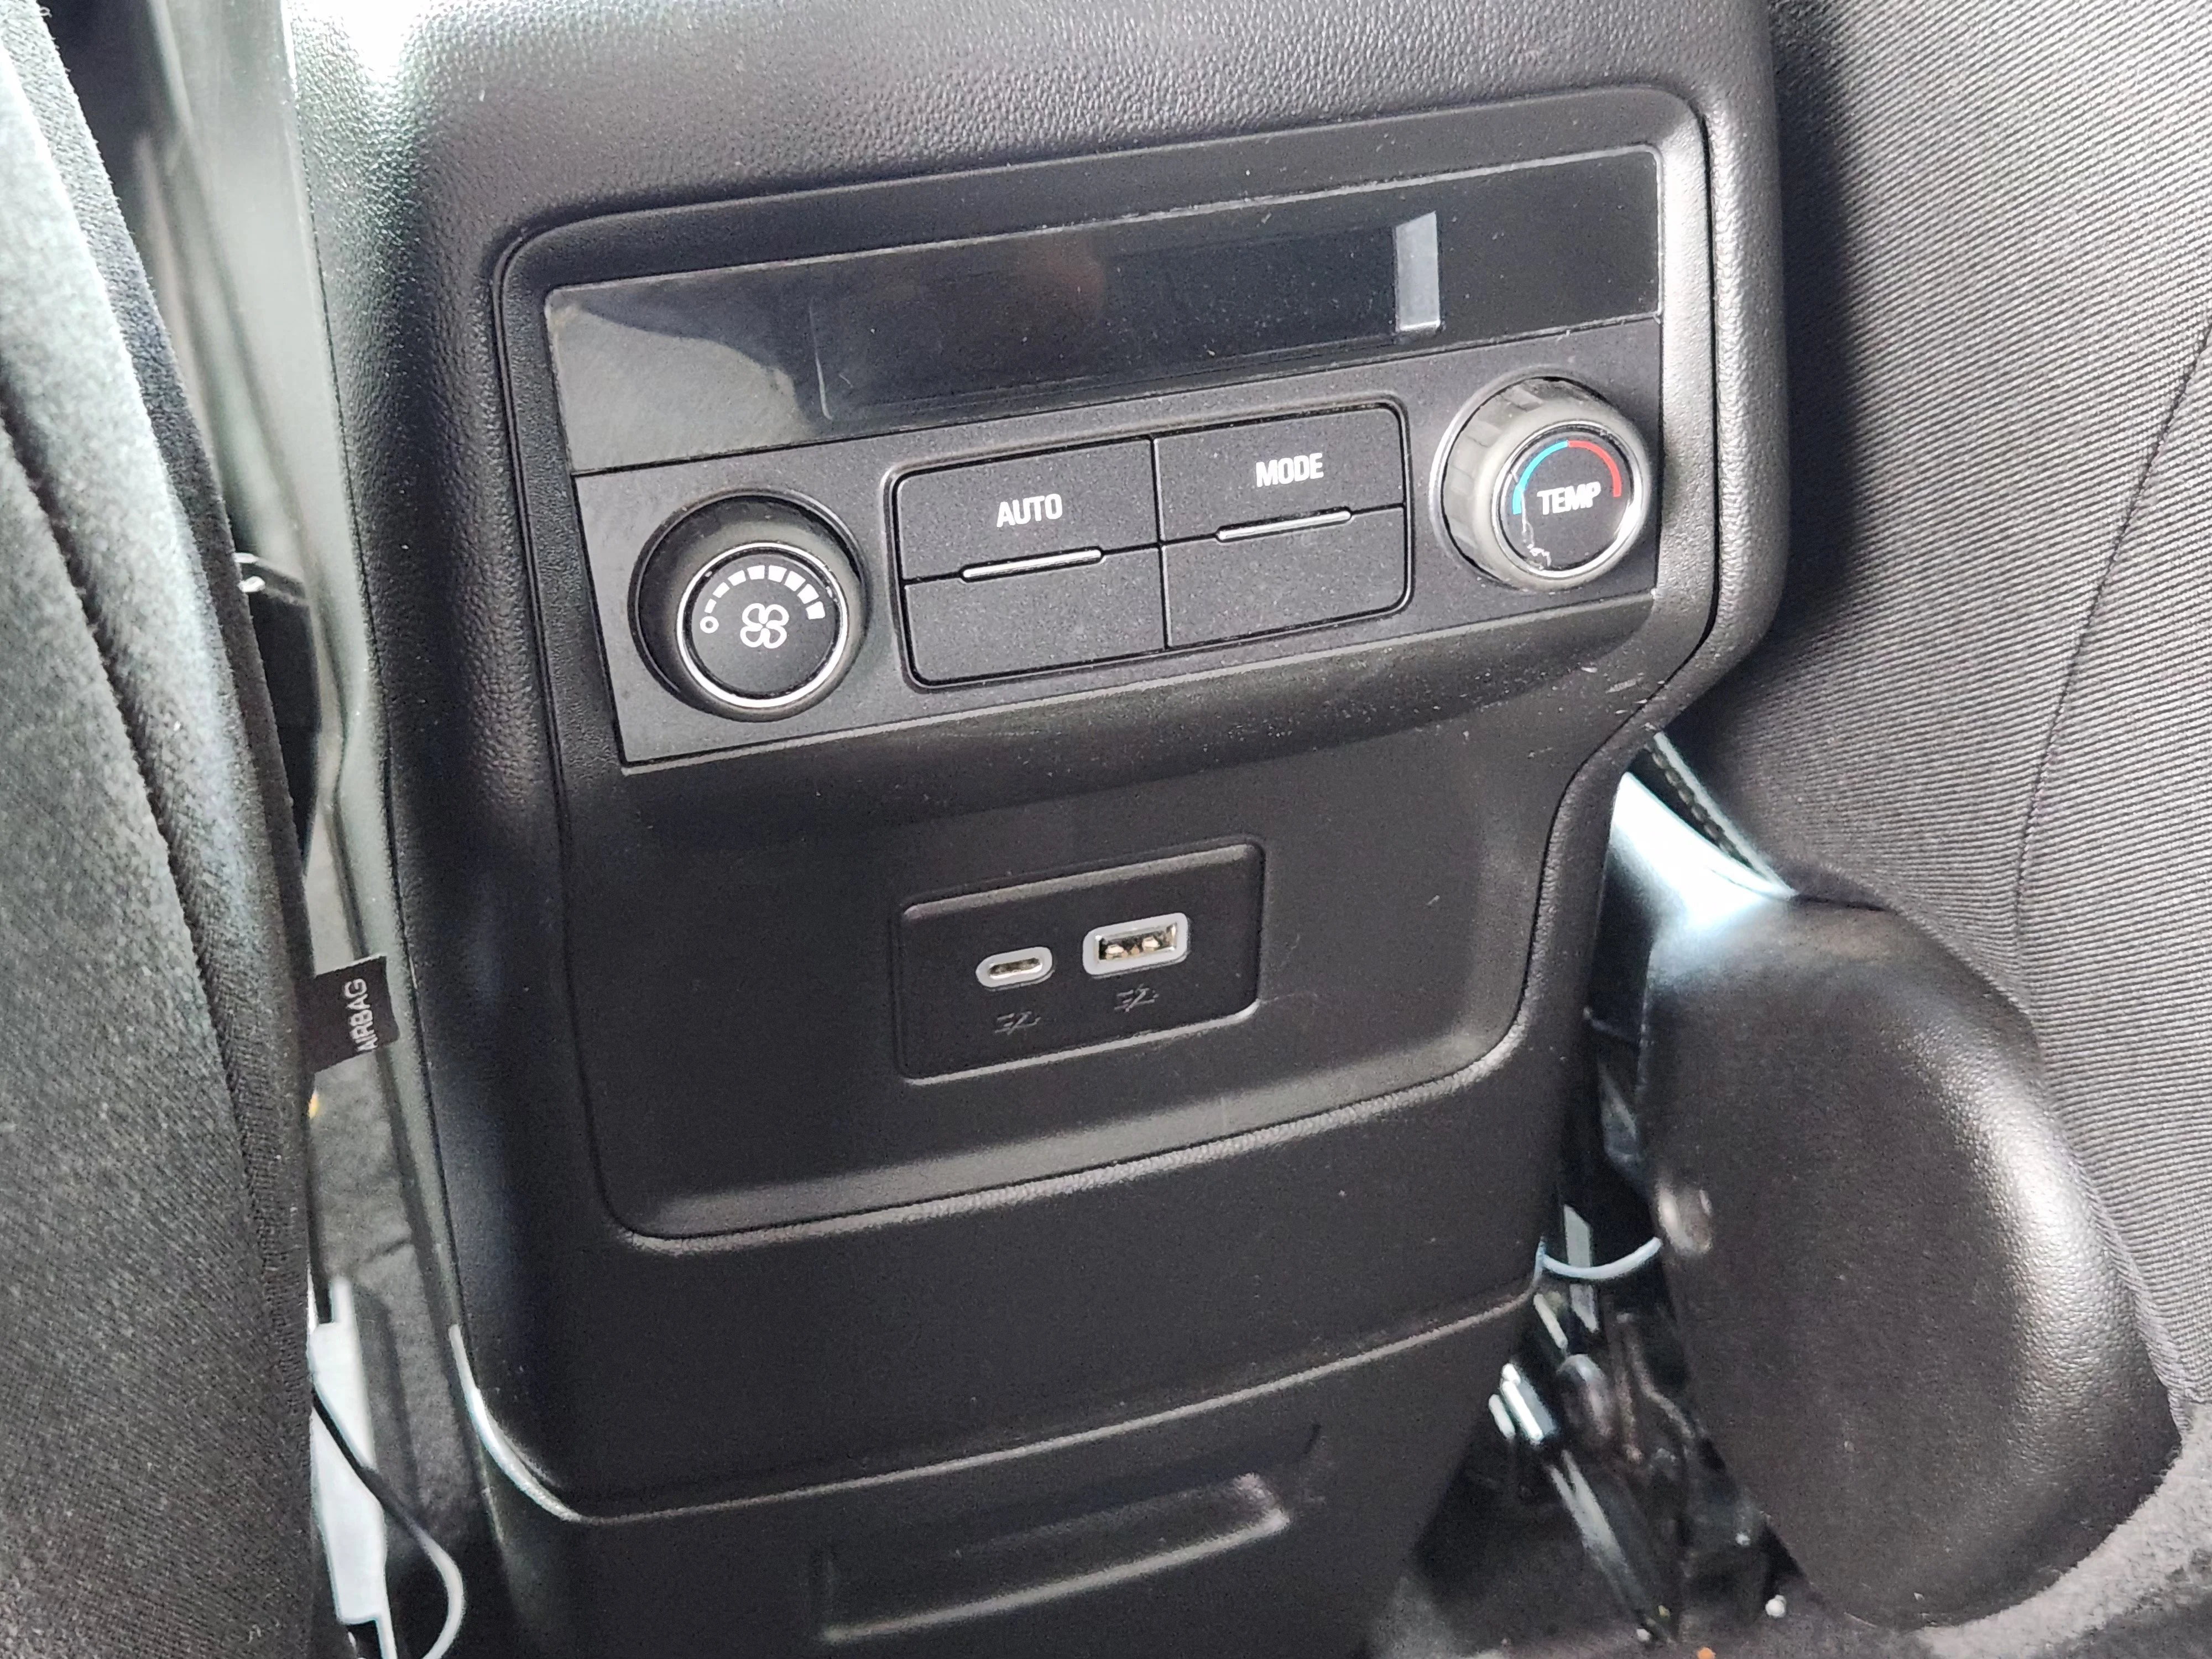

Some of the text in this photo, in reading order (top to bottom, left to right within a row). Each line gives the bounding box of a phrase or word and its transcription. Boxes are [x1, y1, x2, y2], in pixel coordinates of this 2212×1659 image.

[1255, 452, 1324, 487] MODE
[997, 493, 1063, 528] AUTO
[1536, 481, 1601, 515] TEMP
[343, 978, 378, 1052] AIRBAG
